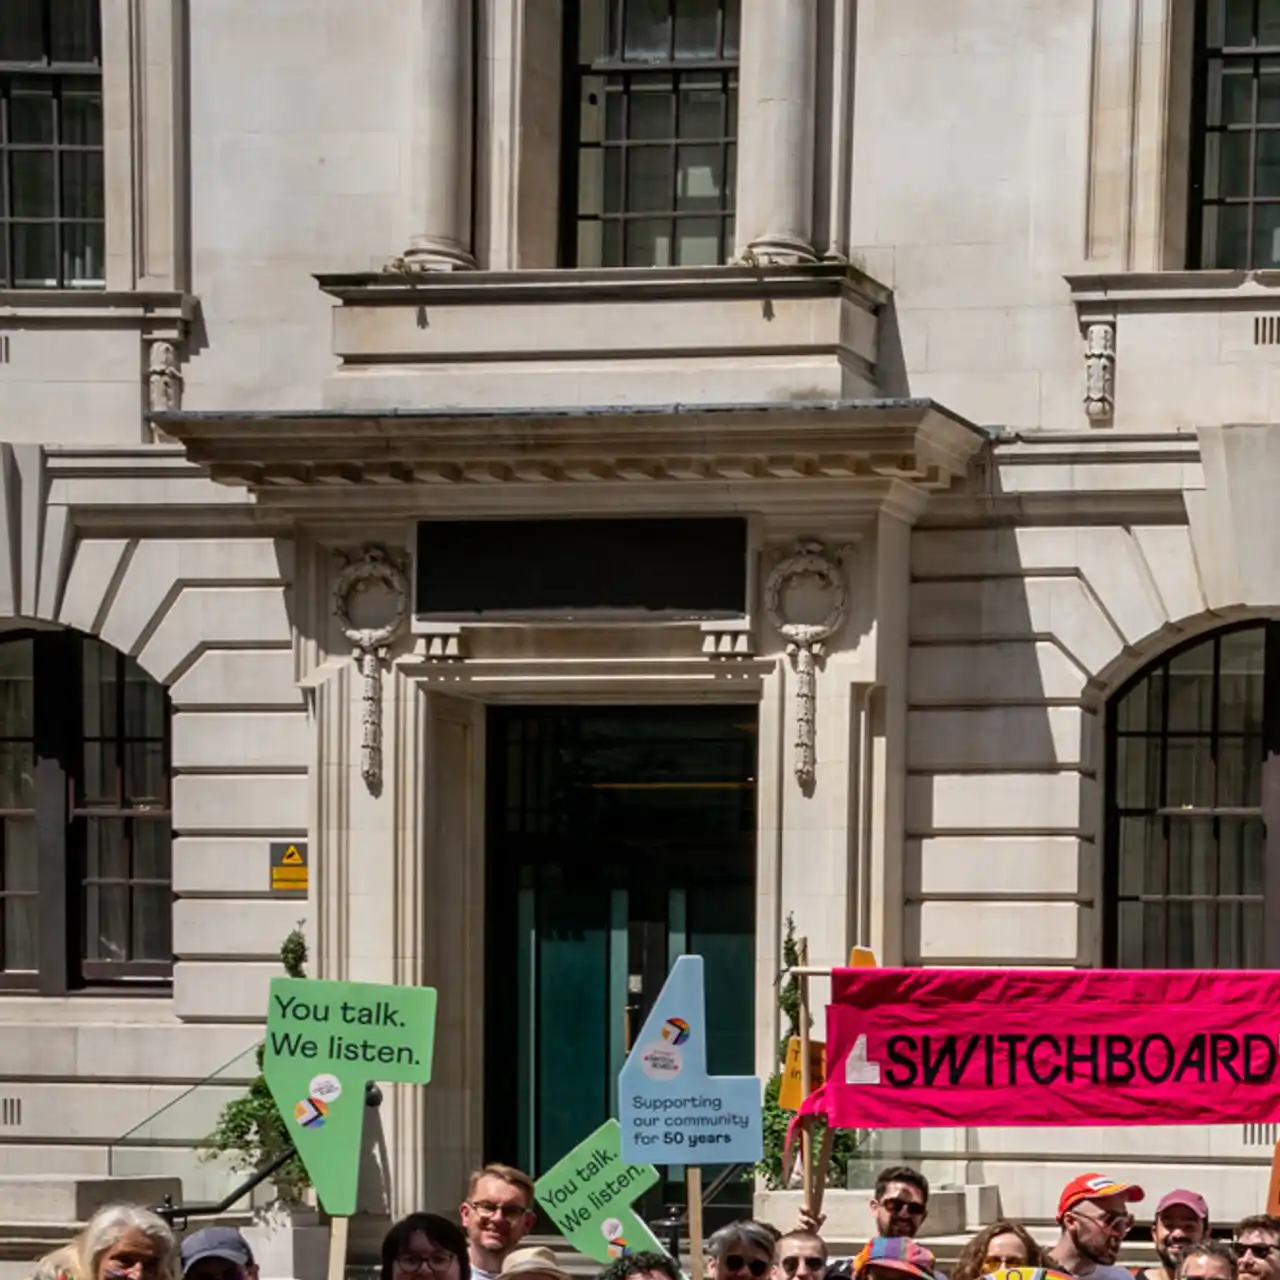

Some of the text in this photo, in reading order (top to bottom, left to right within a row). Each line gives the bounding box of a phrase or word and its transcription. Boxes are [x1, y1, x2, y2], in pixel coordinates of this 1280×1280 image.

[274, 994, 406, 1027] You talk.
[270, 1031, 421, 1066] We listen.
[885, 1033, 1276, 1088] SWITCHBOARD
[632, 1095, 722, 1111] Supporting
[633, 1112, 750, 1129] our community
[633, 1131, 732, 1148] for 50 years
[540, 1148, 618, 1209] You talk.
[558, 1165, 646, 1235] We listen.
